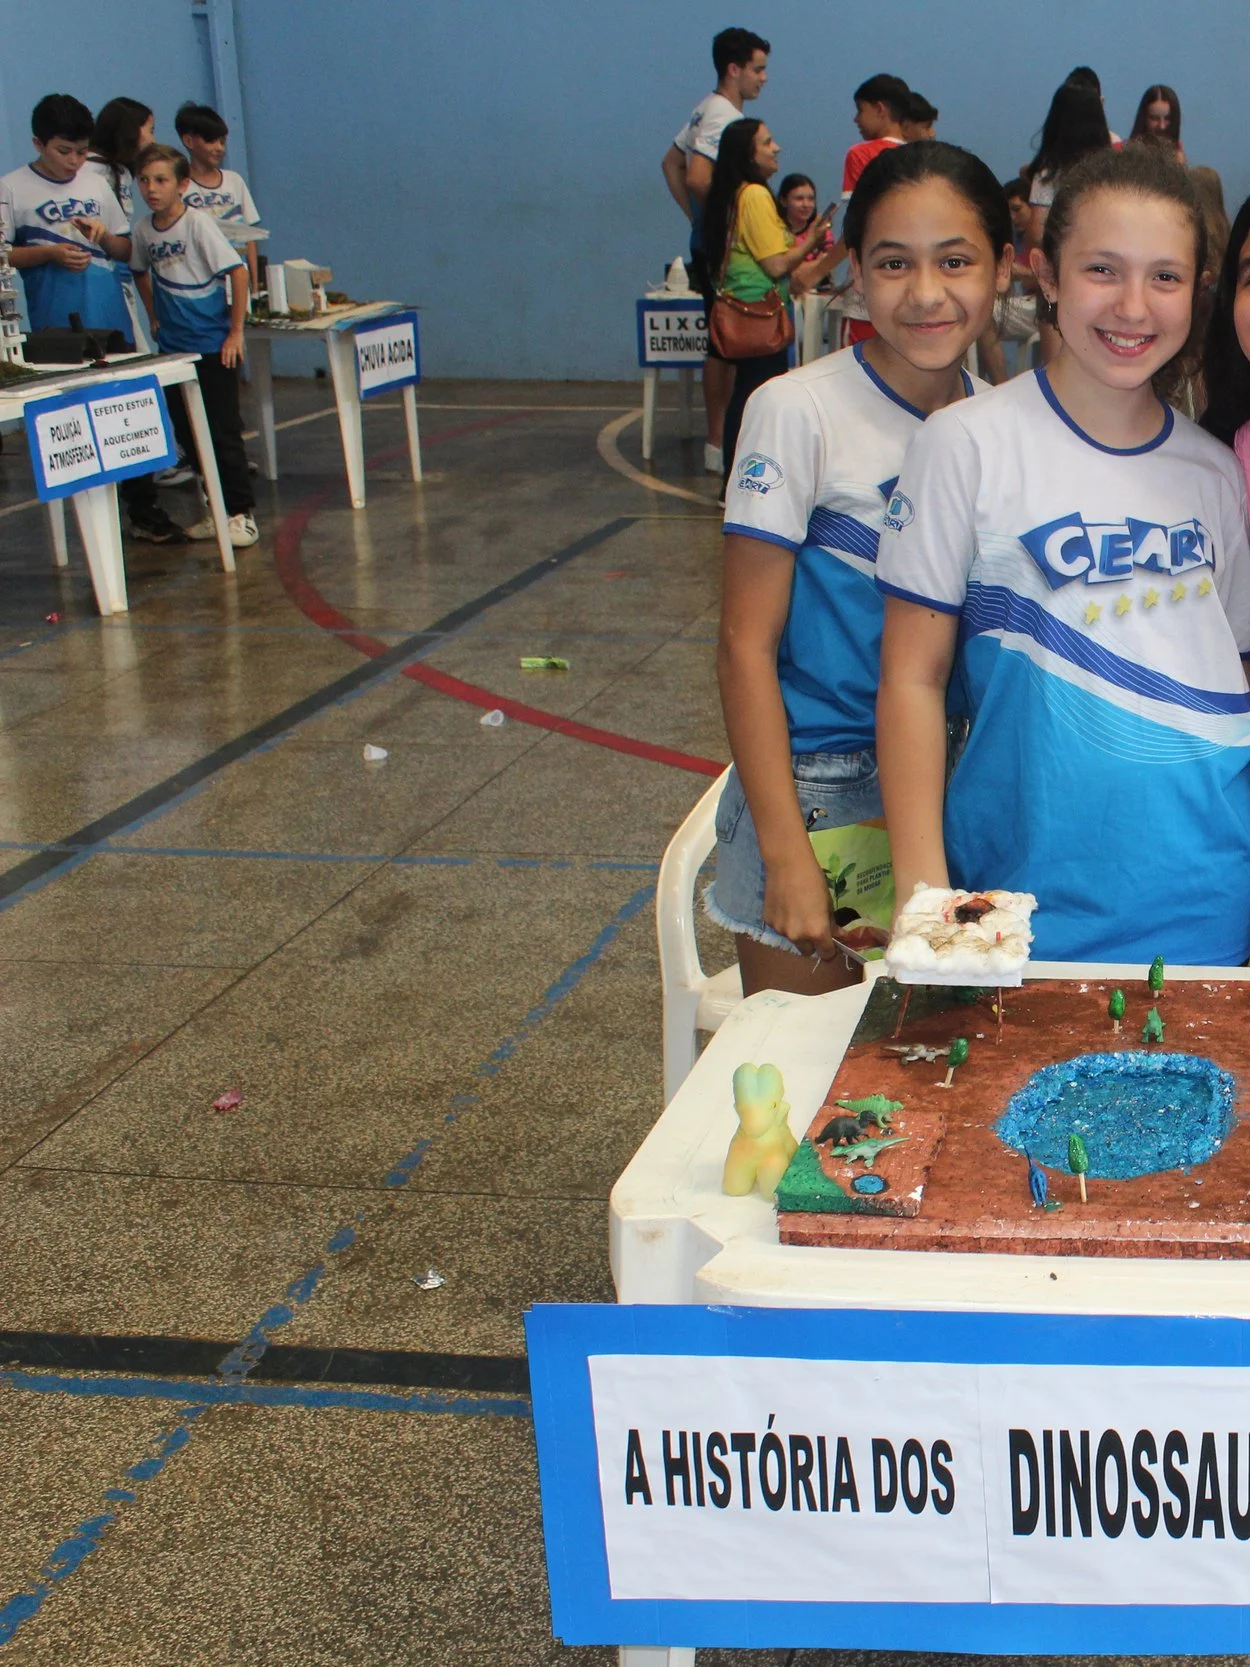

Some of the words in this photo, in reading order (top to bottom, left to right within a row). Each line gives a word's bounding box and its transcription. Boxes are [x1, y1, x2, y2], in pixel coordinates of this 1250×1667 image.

[650, 318, 708, 330] LIXO
[360, 343, 386, 373] CHUVA
[94, 403, 124, 417] EFEITO
[126, 397, 154, 411] ESTUFA
[50, 417, 82, 443] POLUIÇÃO
[124, 418, 130, 427] E
[103, 426, 159, 447] AQUECIMENTO
[119, 445, 151, 459] GLOBAL
[625, 1428, 653, 1506] A
[662, 1413, 861, 1513] HISTÓRIA
[871, 1437, 956, 1516] DOS
